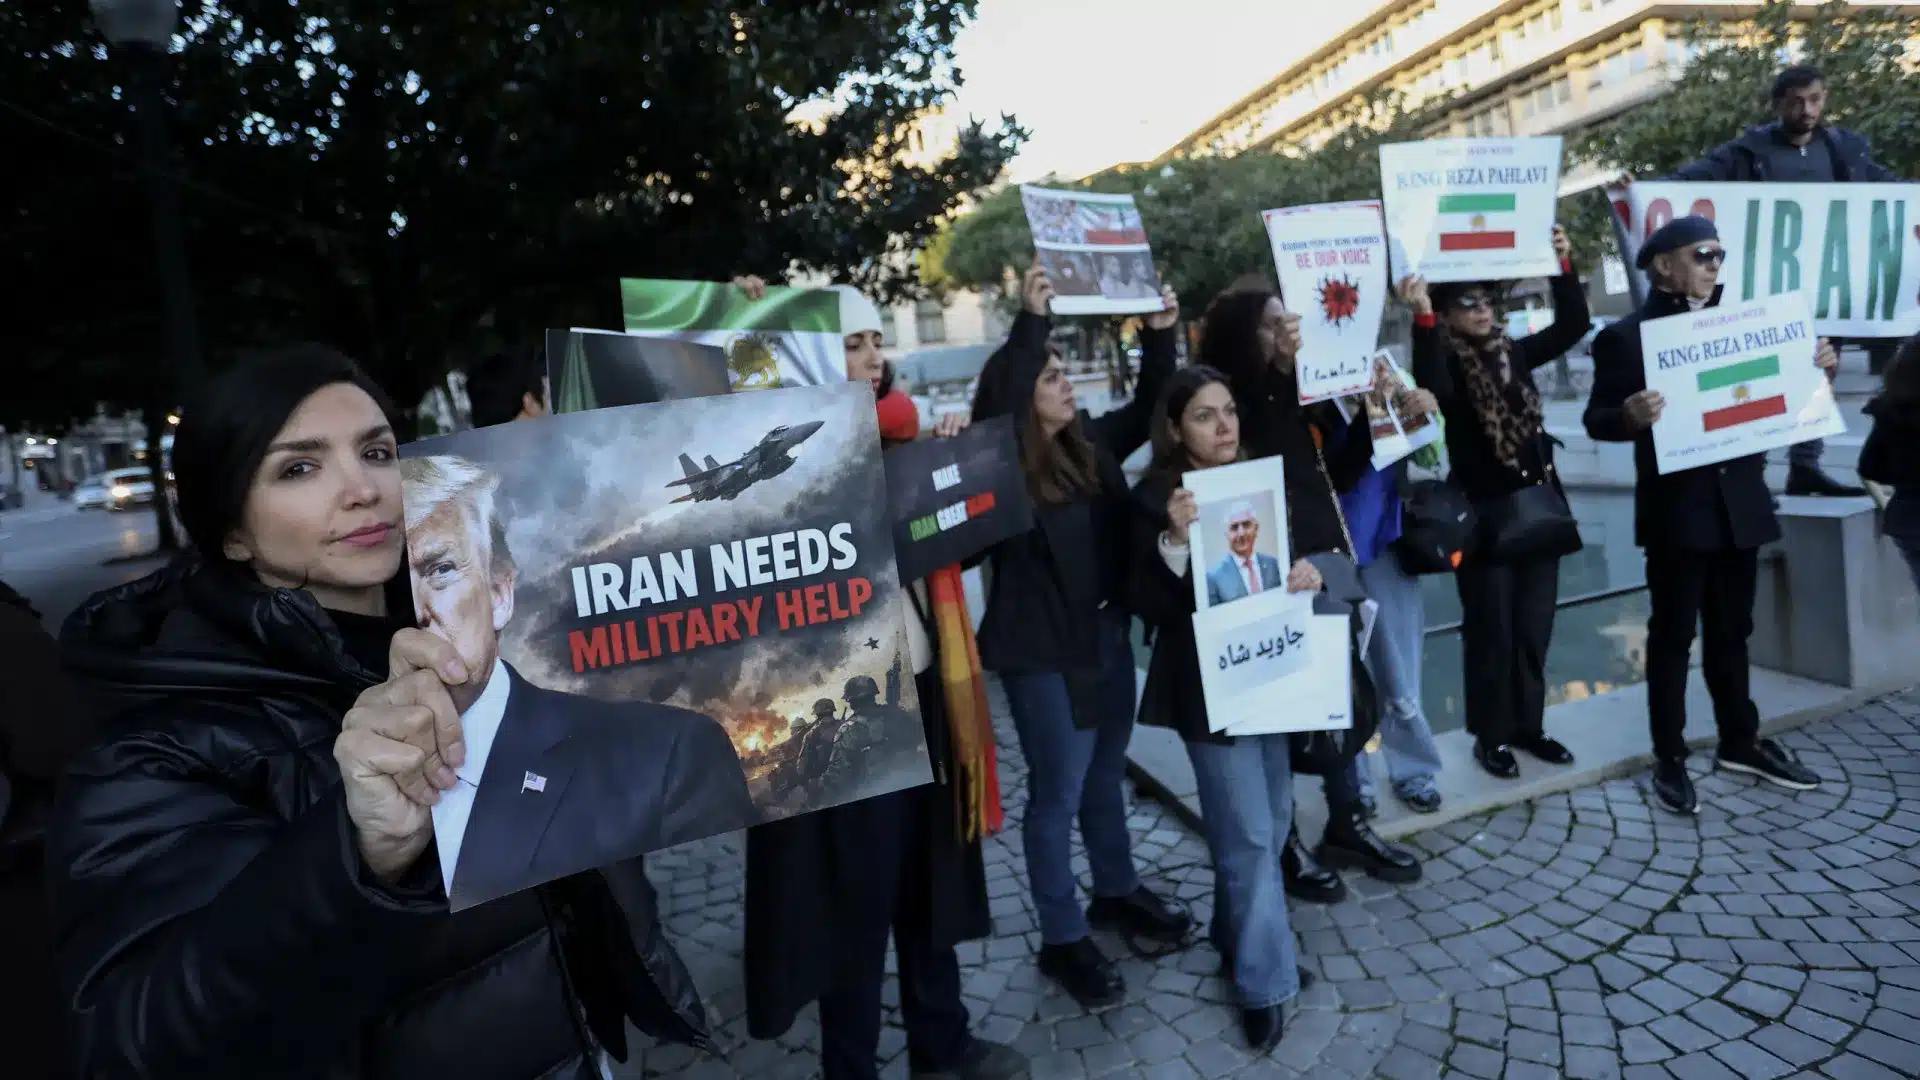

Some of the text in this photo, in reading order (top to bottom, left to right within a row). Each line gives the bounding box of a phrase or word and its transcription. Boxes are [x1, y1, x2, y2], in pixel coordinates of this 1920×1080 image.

[1396, 166, 1548, 190] KING REZA PAHLAVI
[1296, 248, 1370, 269] BE OUR VOICE
[1742, 199, 1905, 320] IRAN
[1657, 320, 1807, 370] KING REZA PAHLAVI
[571, 522, 858, 618] IRAN NEEDS
[568, 577, 873, 673] MILITARY HELP
[1218, 624, 1304, 670] جاوید شاه
